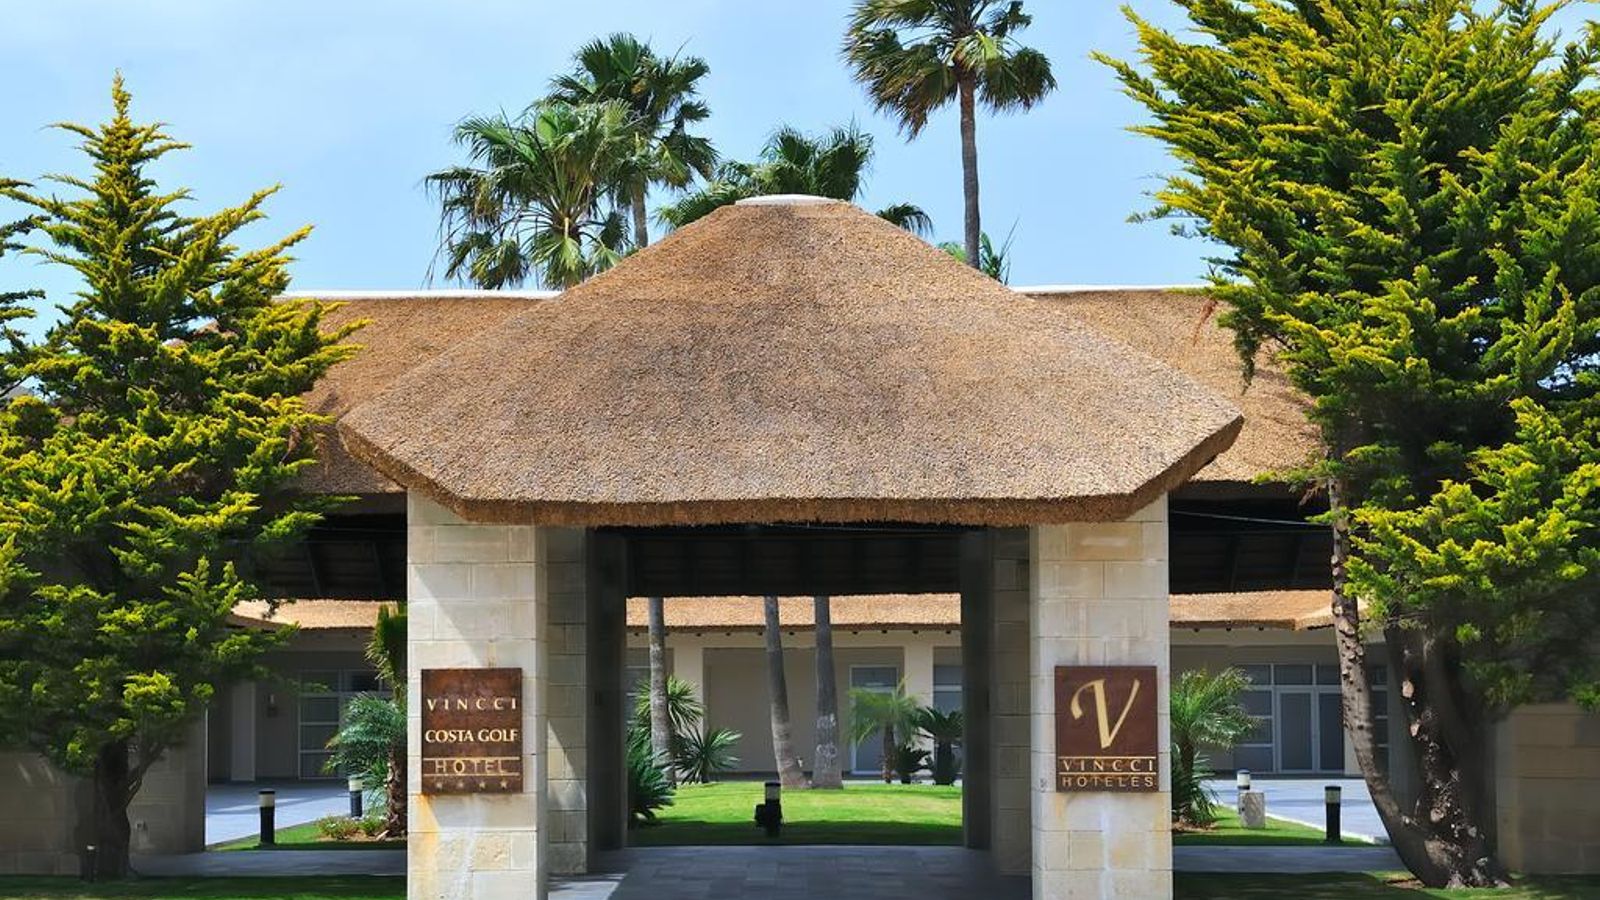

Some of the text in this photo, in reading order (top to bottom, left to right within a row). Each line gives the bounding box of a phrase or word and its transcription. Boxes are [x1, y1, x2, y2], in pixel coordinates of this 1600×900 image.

[426, 698, 516, 711] VINCCI
[1070, 678, 1140, 749] V
[425, 728, 519, 742] COSTA GOLF
[435, 760, 508, 773] HOTEL
[1063, 759, 1153, 771] VINCCI
[1062, 777, 1154, 787] HOTELES
